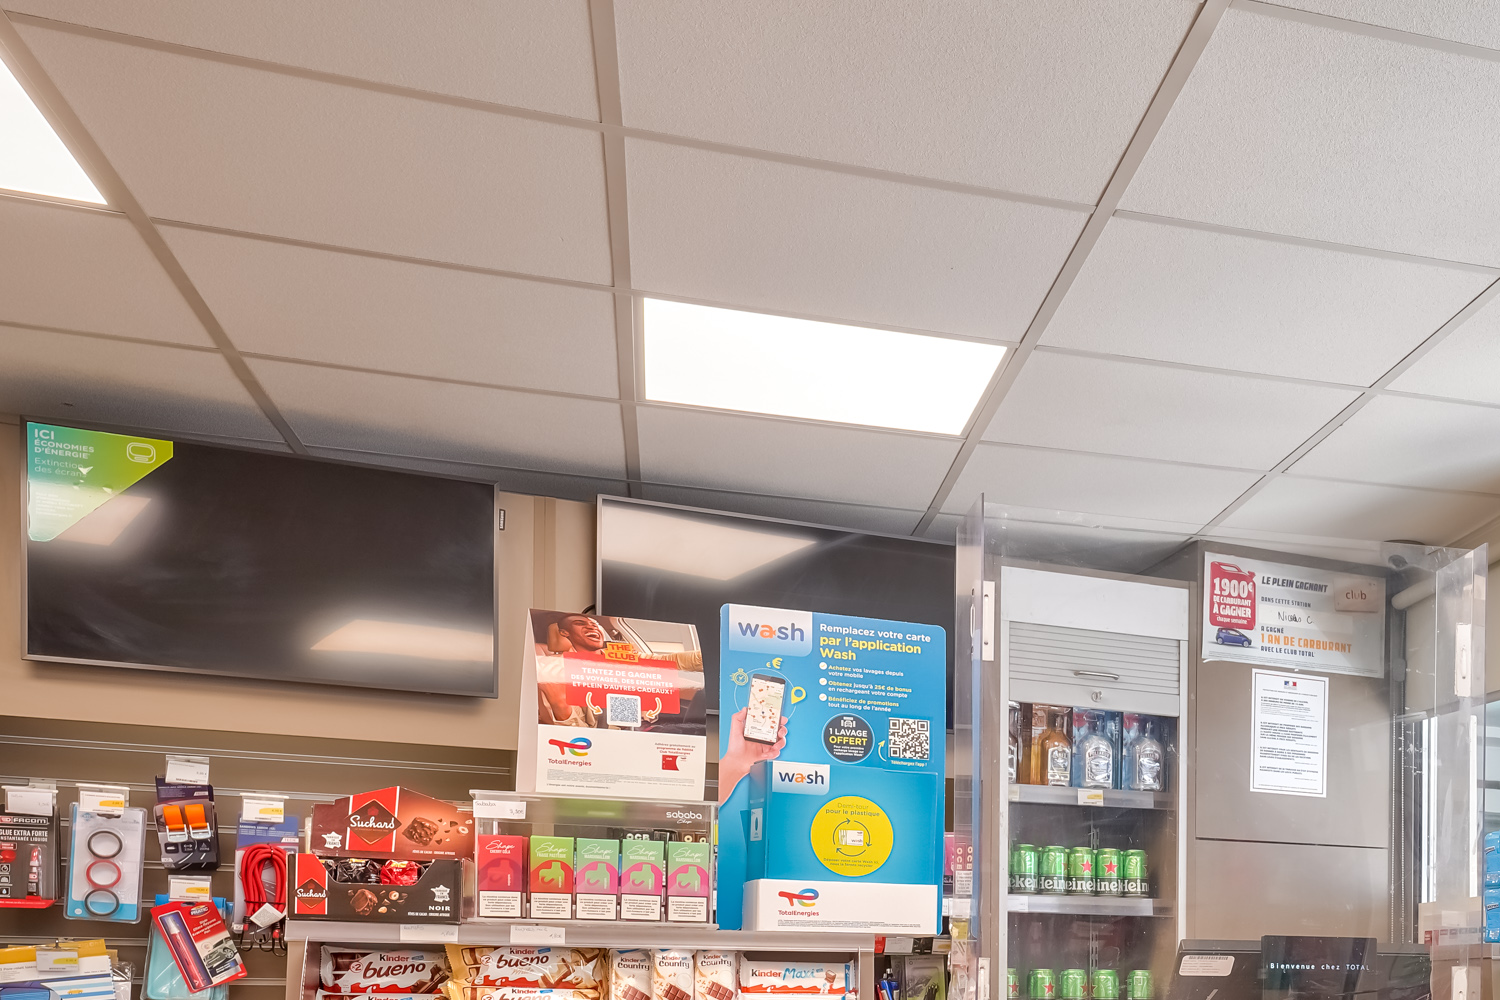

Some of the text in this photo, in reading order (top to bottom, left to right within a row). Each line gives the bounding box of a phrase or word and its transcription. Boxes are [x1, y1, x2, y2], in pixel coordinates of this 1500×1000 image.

[35, 429, 54, 439] ICI
[34, 439, 94, 452] ÉCONOMIES
[34, 447, 88, 459] D'ÉNERGIE
[35, 466, 52, 474] des
[1213, 577, 1252, 598] 1900€
[1262, 576, 1328, 592] LE PLEIN GAGNANT
[1345, 590, 1366, 600] club
[1220, 596, 1251, 606] CARBURANT
[1220, 606, 1251, 618] GAGNER
[738, 622, 804, 642] wash
[820, 624, 931, 643] Remplacez votre carte
[609, 643, 630, 651] THE
[820, 636, 921, 655] par l'application
[1261, 633, 1351, 653] 1 AN DE CARBURANT
[608, 652, 636, 661] CLUB
[820, 648, 856, 661] Wash
[1298, 649, 1314, 657] TOTAL
[628, 671, 662, 680] GAGNER
[863, 667, 884, 676] lavages
[636, 680, 673, 688] ENCEINTES
[835, 728, 867, 737] LAVAGE
[829, 736, 867, 746] OFFERT
[548, 758, 591, 766] TotalEnergies
[778, 771, 824, 785] wash
[837, 802, 869, 810] Demi-tour
[666, 810, 702, 820] sababa
[350, 815, 395, 829] Suchard
[296, 889, 326, 898] Suchard
[363, 962, 426, 979] bueno
[617, 962, 650, 971] Country
[783, 967, 815, 980] Maxi
